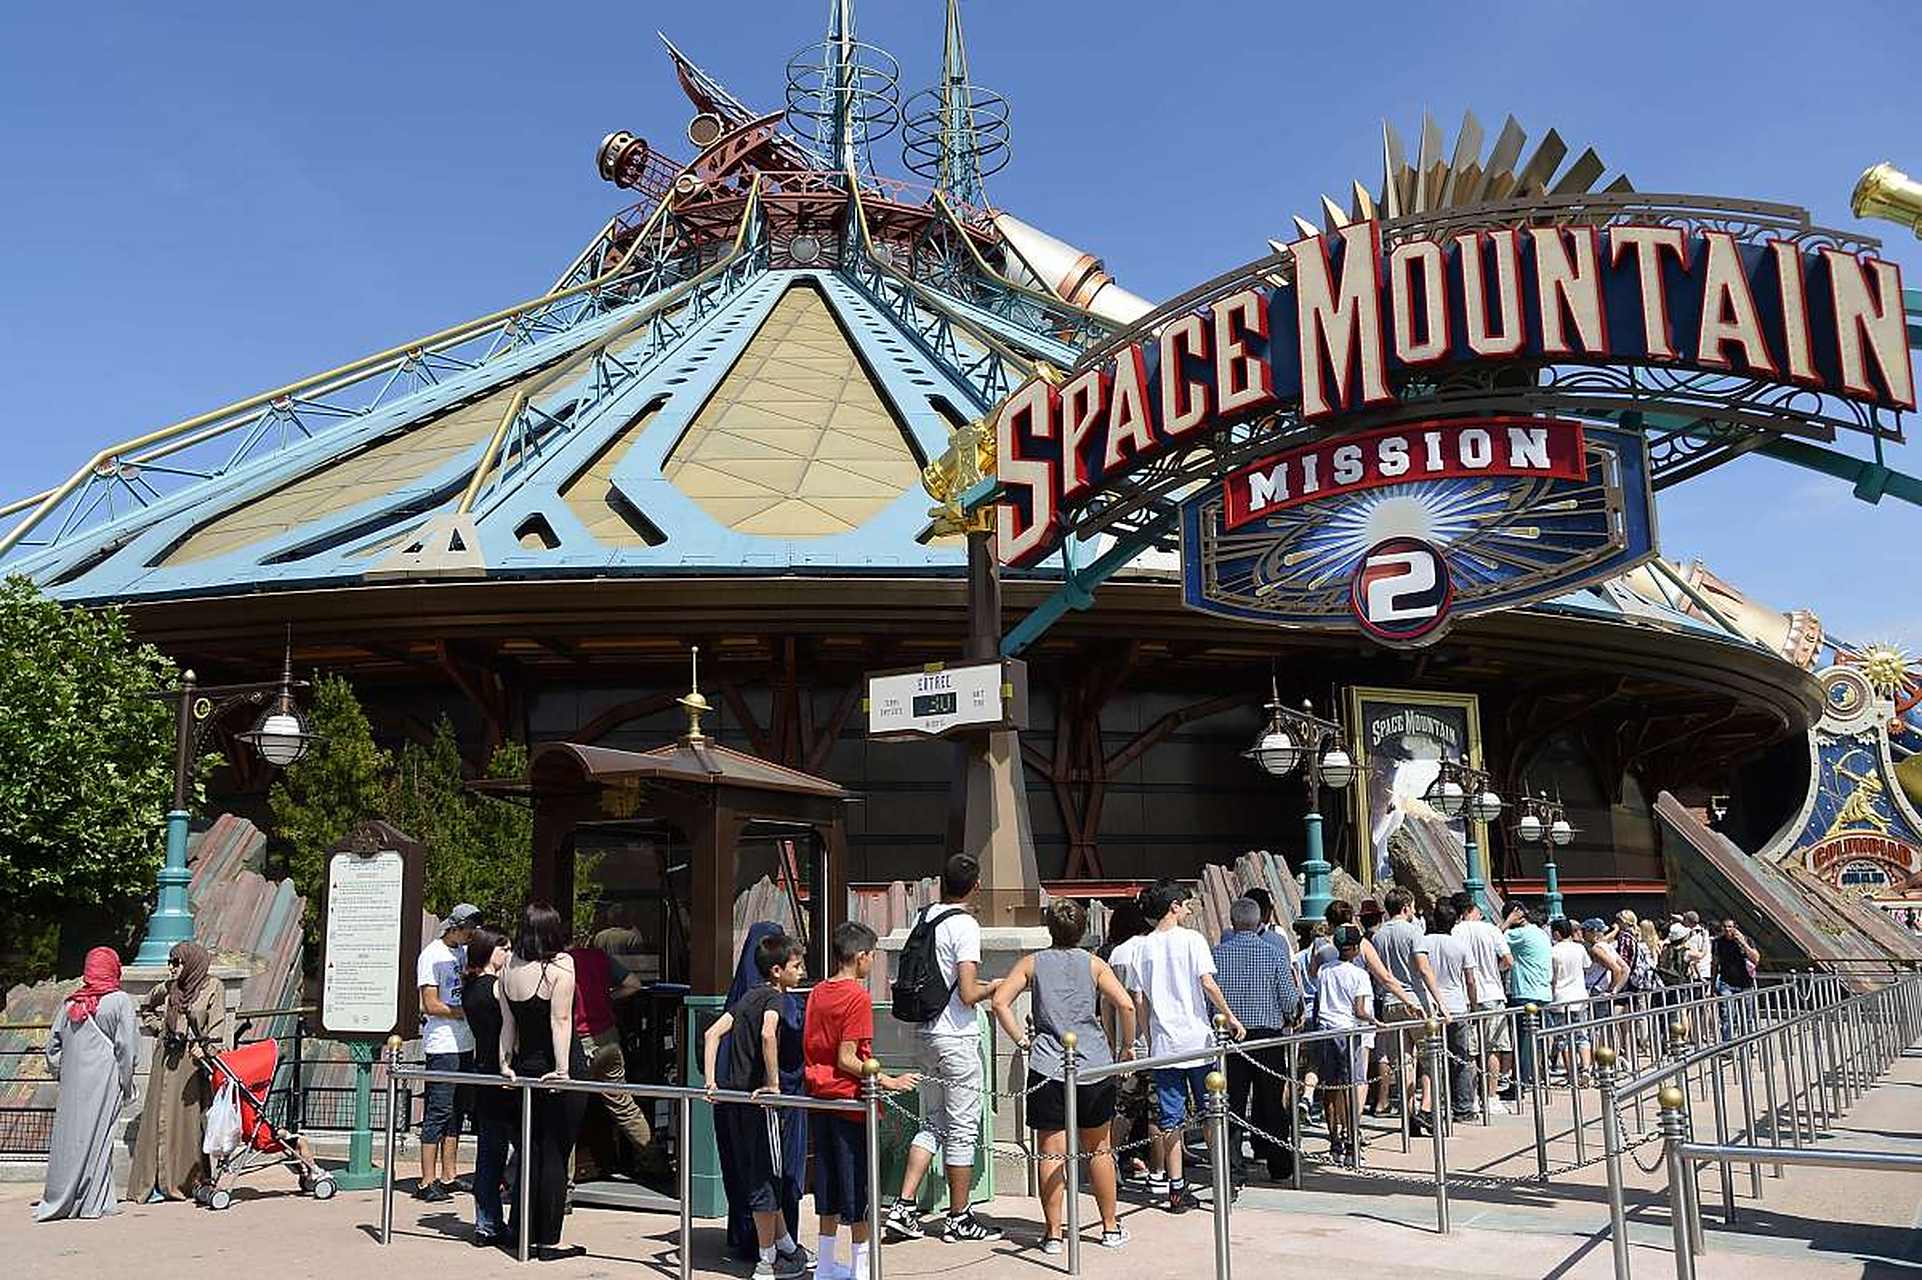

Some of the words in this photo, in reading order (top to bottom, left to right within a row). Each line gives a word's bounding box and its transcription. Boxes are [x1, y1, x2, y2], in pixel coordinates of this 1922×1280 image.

[997, 288, 1275, 568] SPACE
[1288, 218, 1917, 421] MOUNTAIN
[1248, 427, 1551, 512] MISSION
[1365, 550, 1438, 623] 2
[1372, 715, 1404, 746] SPACE
[1404, 709, 1457, 744] MOUNTAIN
